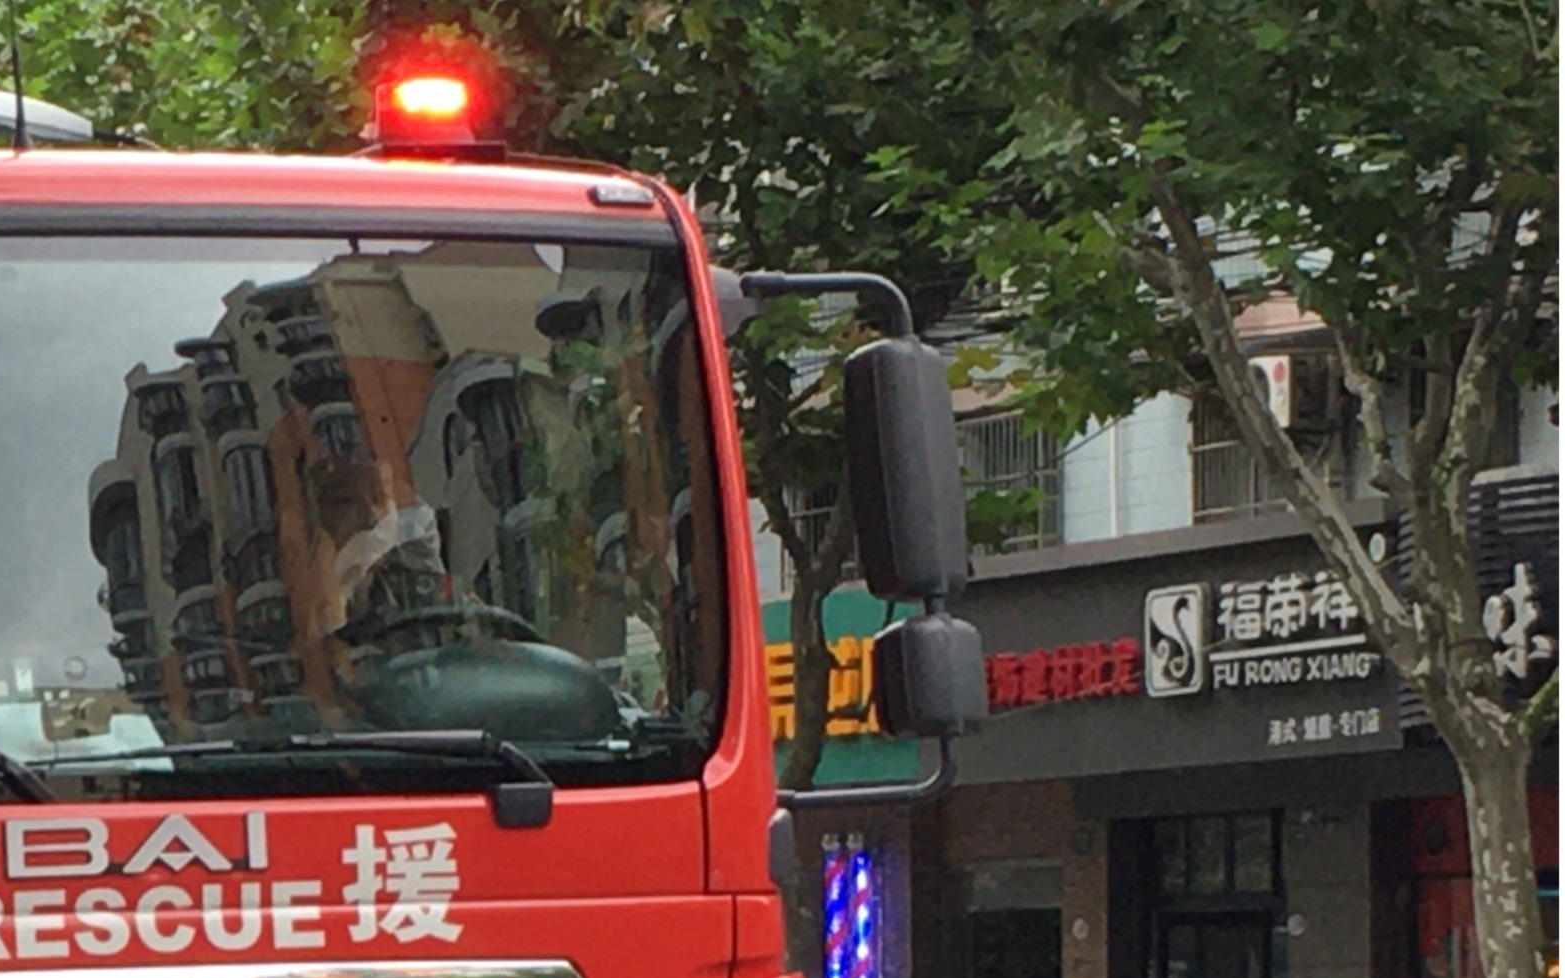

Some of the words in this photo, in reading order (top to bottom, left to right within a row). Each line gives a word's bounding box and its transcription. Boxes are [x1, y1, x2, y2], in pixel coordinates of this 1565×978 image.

[1217, 571, 1358, 640] 福荣祥
[1213, 661, 1240, 689] FU
[1245, 656, 1302, 686] RONG
[1306, 652, 1371, 680] XIANG
[5, 811, 269, 878] BAI
[341, 823, 464, 943] 援
